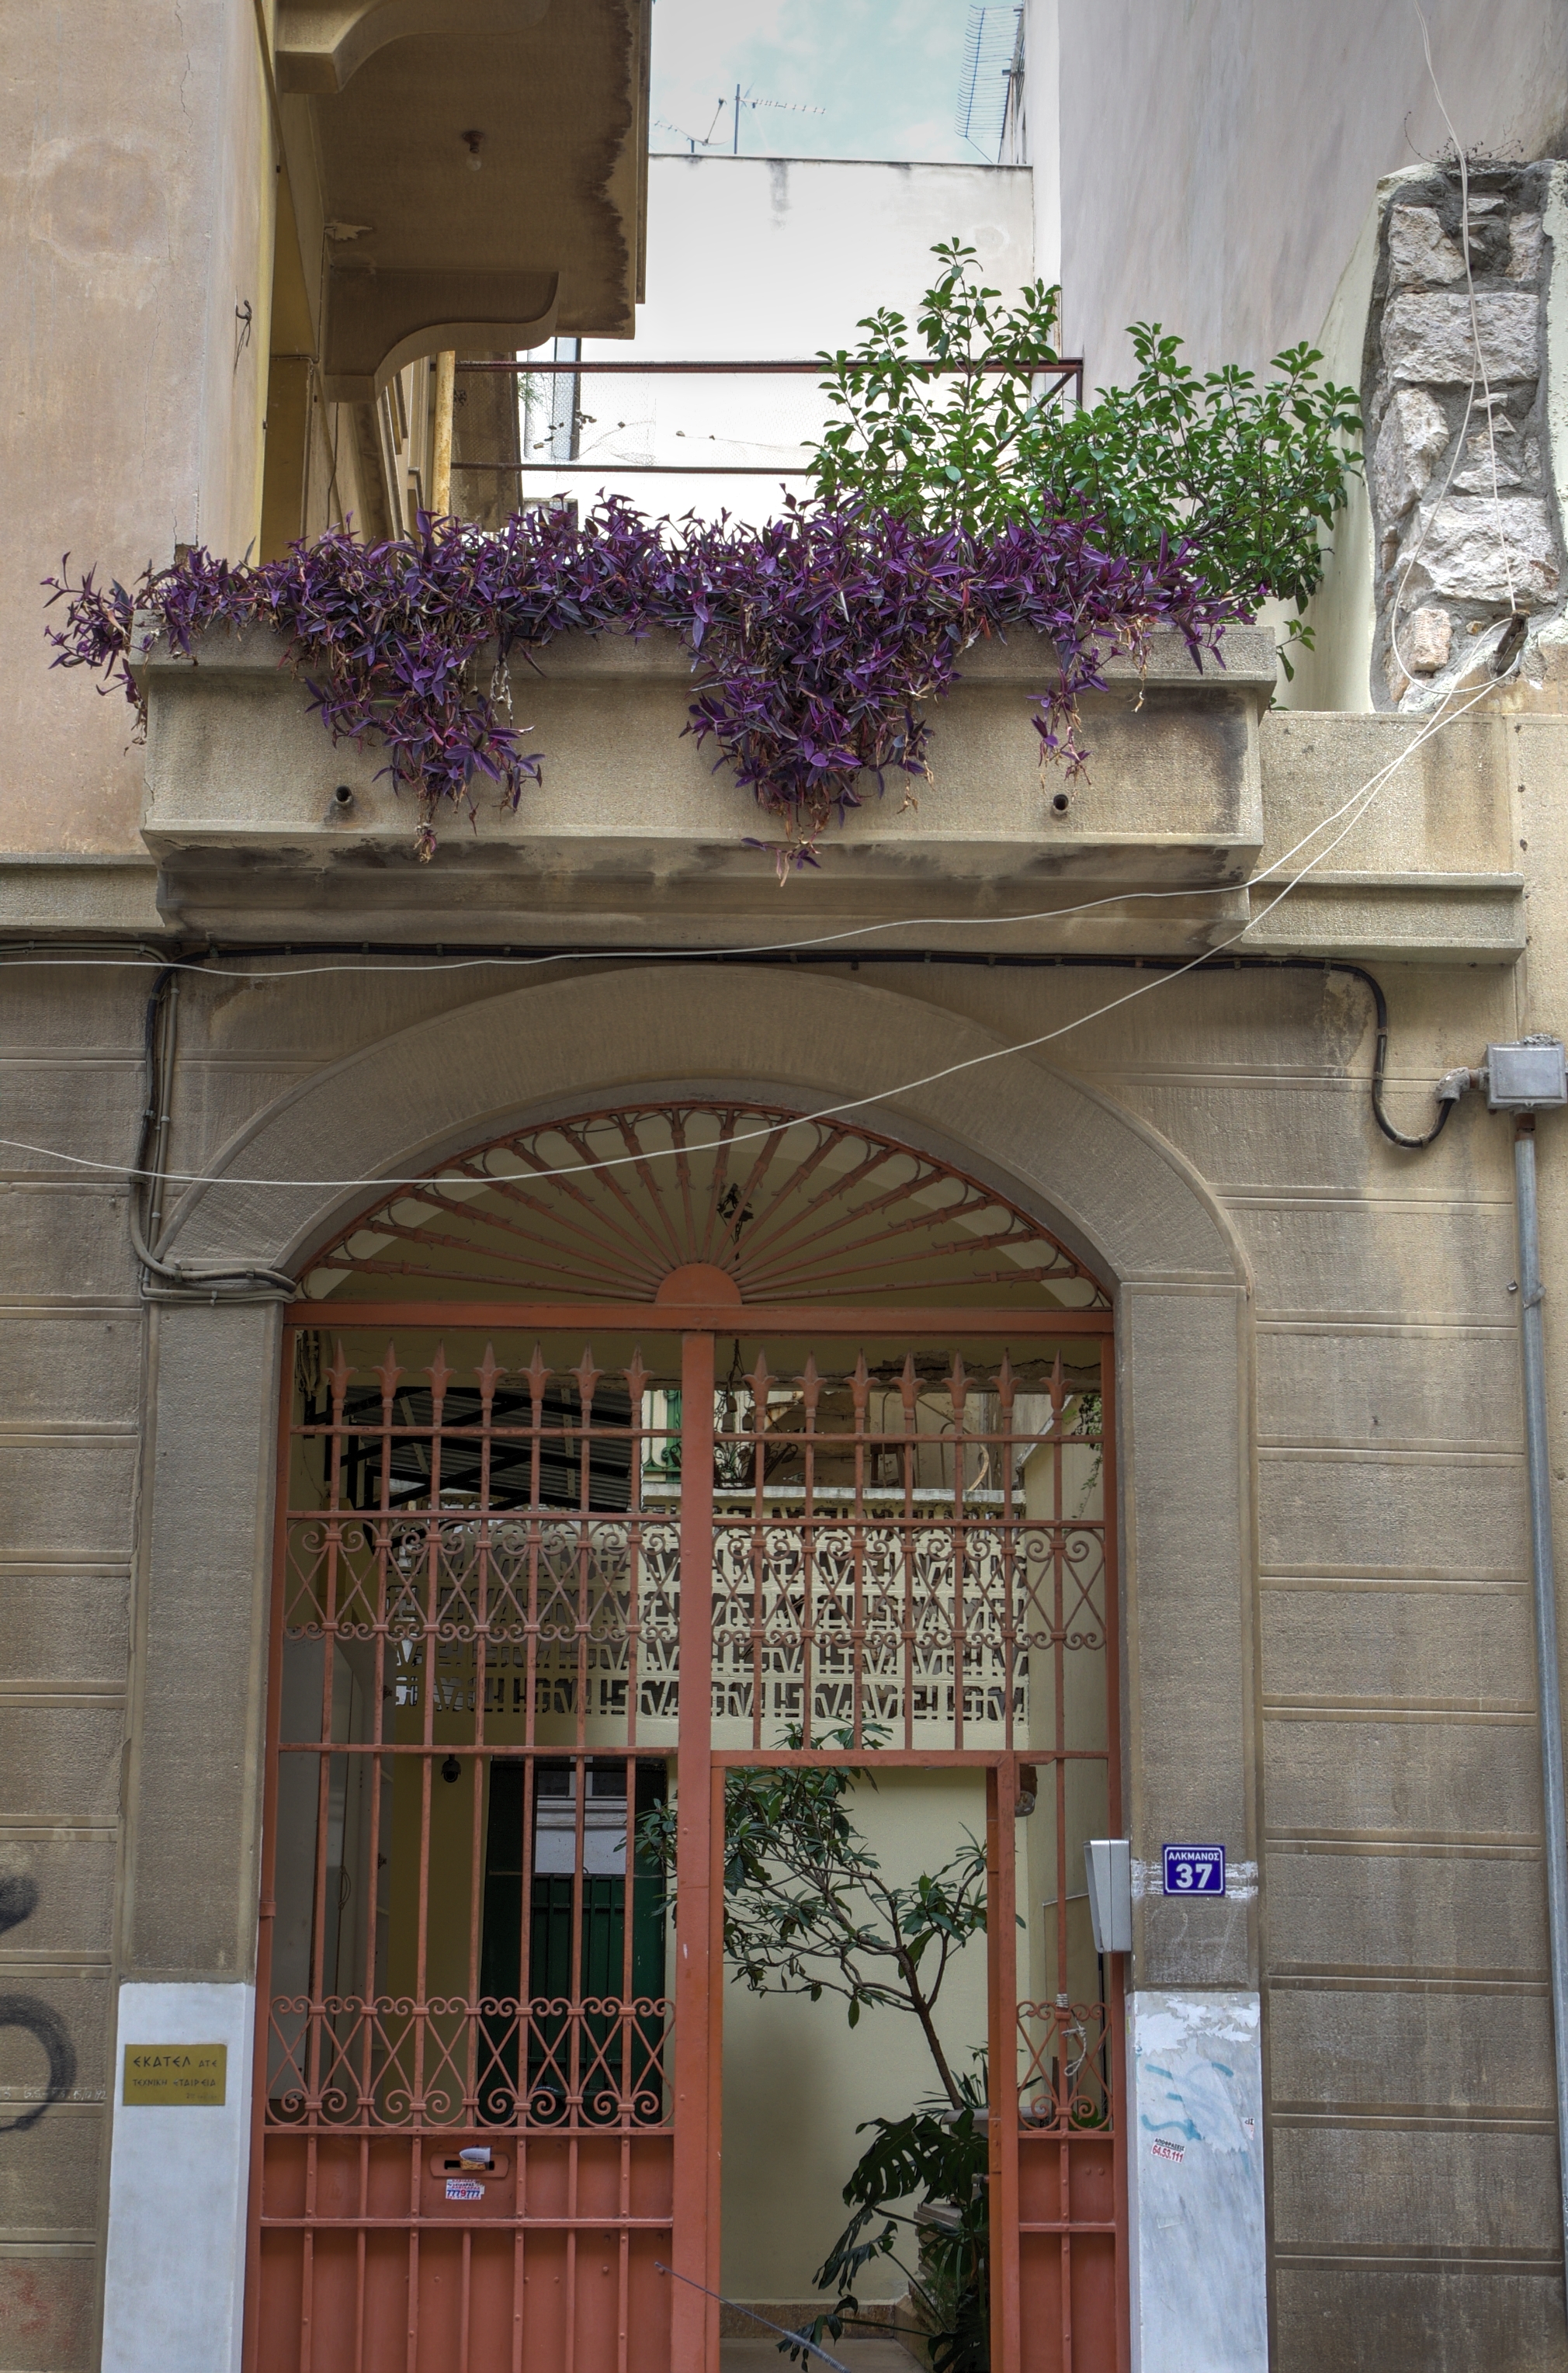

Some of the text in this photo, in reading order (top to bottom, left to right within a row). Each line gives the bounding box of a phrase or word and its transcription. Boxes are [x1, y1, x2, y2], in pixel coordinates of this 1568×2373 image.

[1168, 1851, 1219, 1861] ΑΛΚΜΑΝΟΣ
[1175, 1863, 1213, 1889] 37
[133, 2056, 217, 2068] ΕΚΑΤΕΛ ΑΤΕ
[1152, 2145, 1184, 2163] 64.53.111
